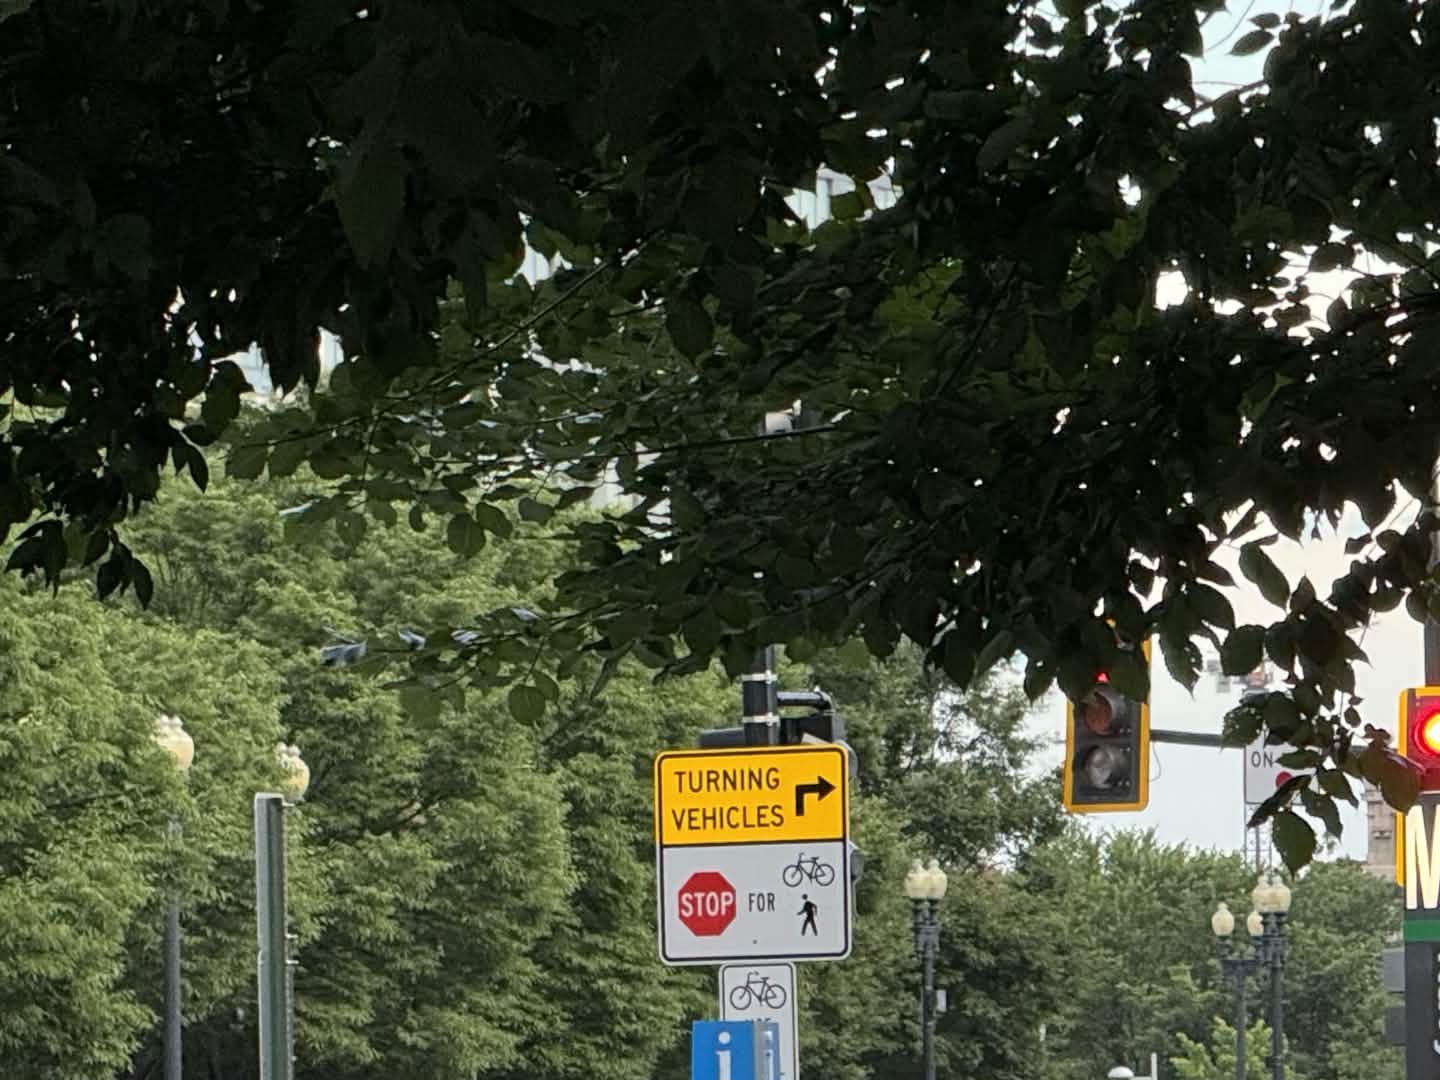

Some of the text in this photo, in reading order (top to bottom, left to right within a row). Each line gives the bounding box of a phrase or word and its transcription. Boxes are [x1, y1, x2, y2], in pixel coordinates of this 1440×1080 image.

[1251, 751, 1273, 768] ON
[673, 767, 780, 793] TURNING
[671, 804, 785, 831] VEHICLES
[681, 891, 776, 918] STOP FOR
